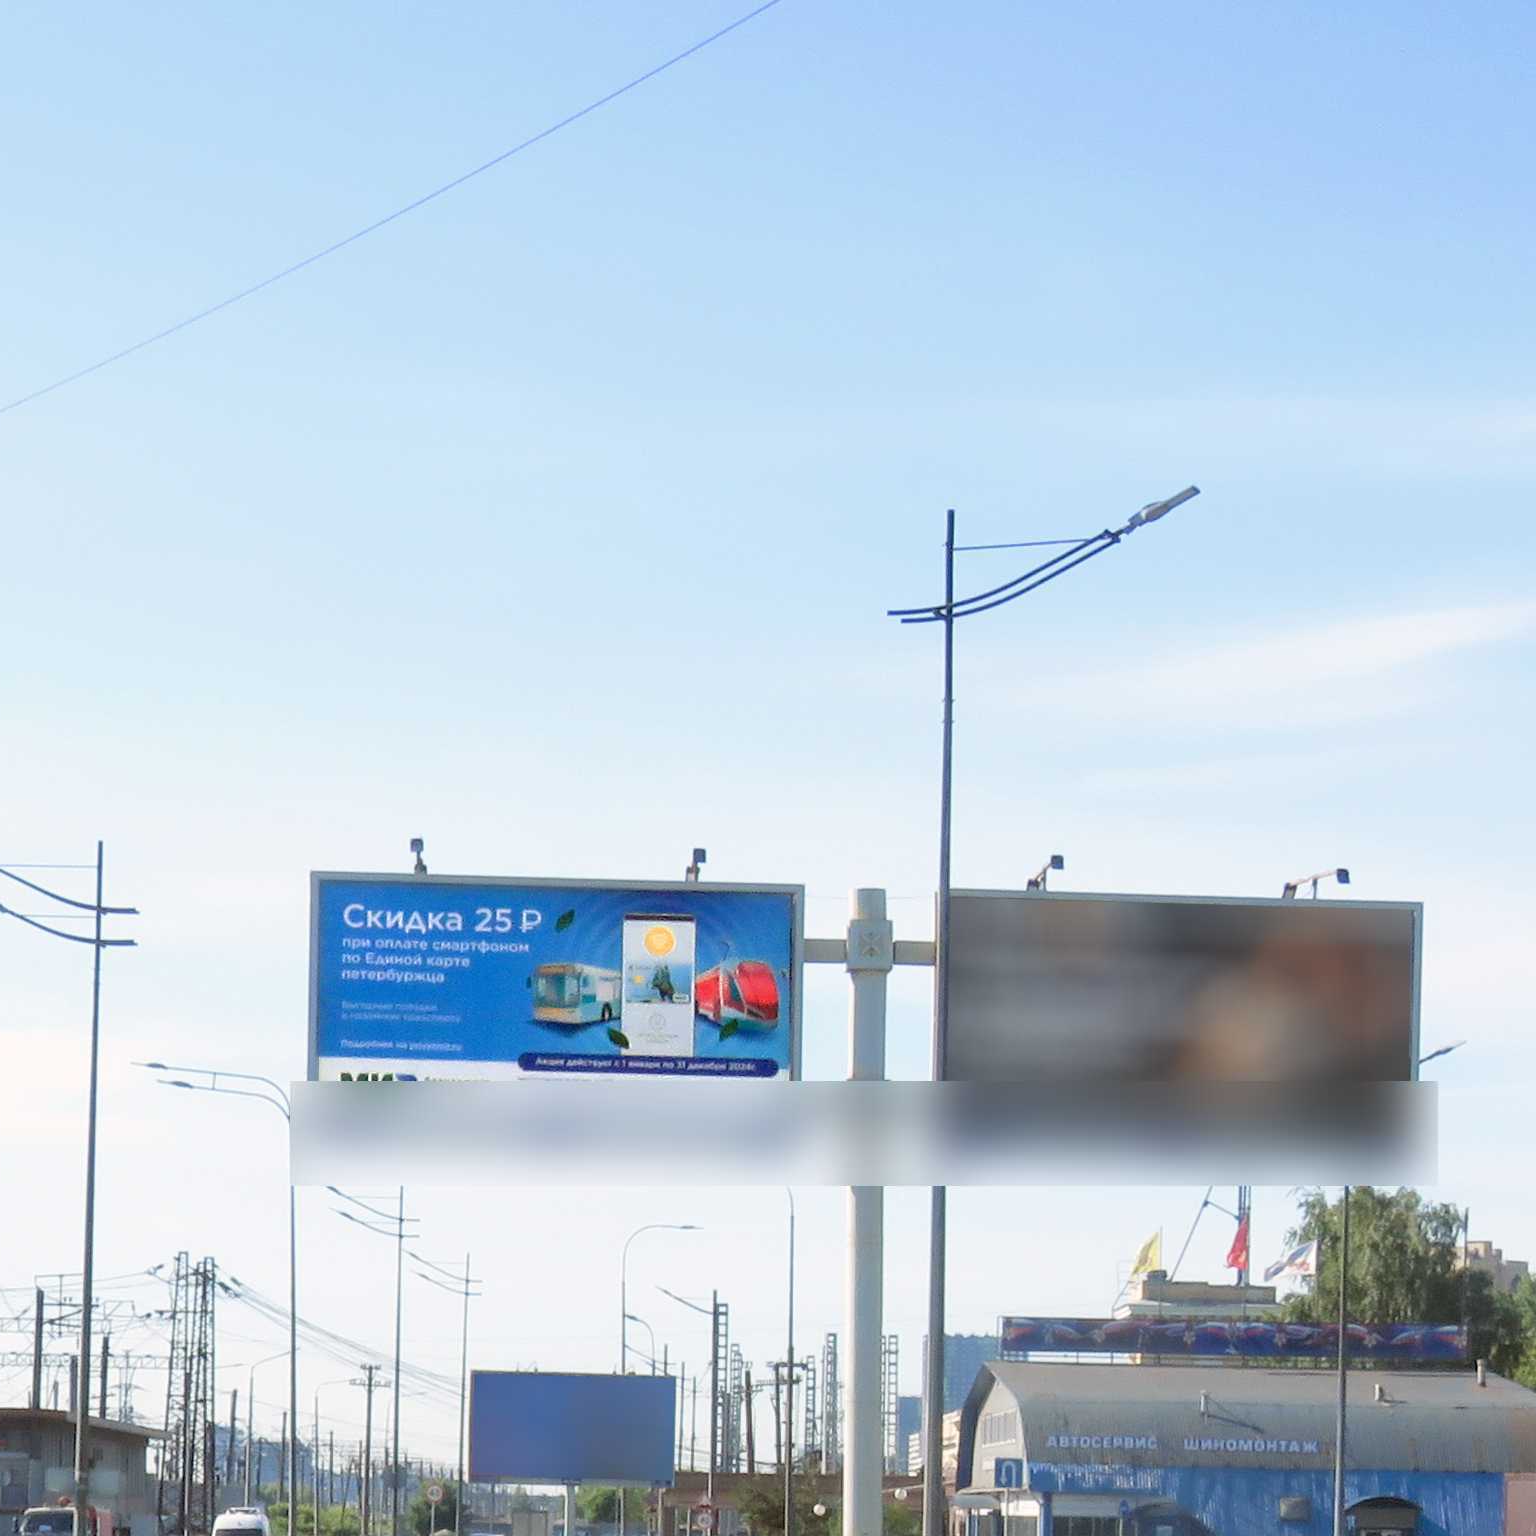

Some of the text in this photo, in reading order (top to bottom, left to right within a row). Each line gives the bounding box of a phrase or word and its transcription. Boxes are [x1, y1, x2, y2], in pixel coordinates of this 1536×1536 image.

[343, 903, 464, 934] Скидка
[475, 908, 512, 932] 25
[342, 937, 530, 953] при оплате смартфоном
[342, 951, 471, 968] по Единой карте
[341, 968, 445, 983] петербуржца
[1047, 1435, 1319, 1454] АВТОСЕРВИС ШИНОМОНТАЖ
